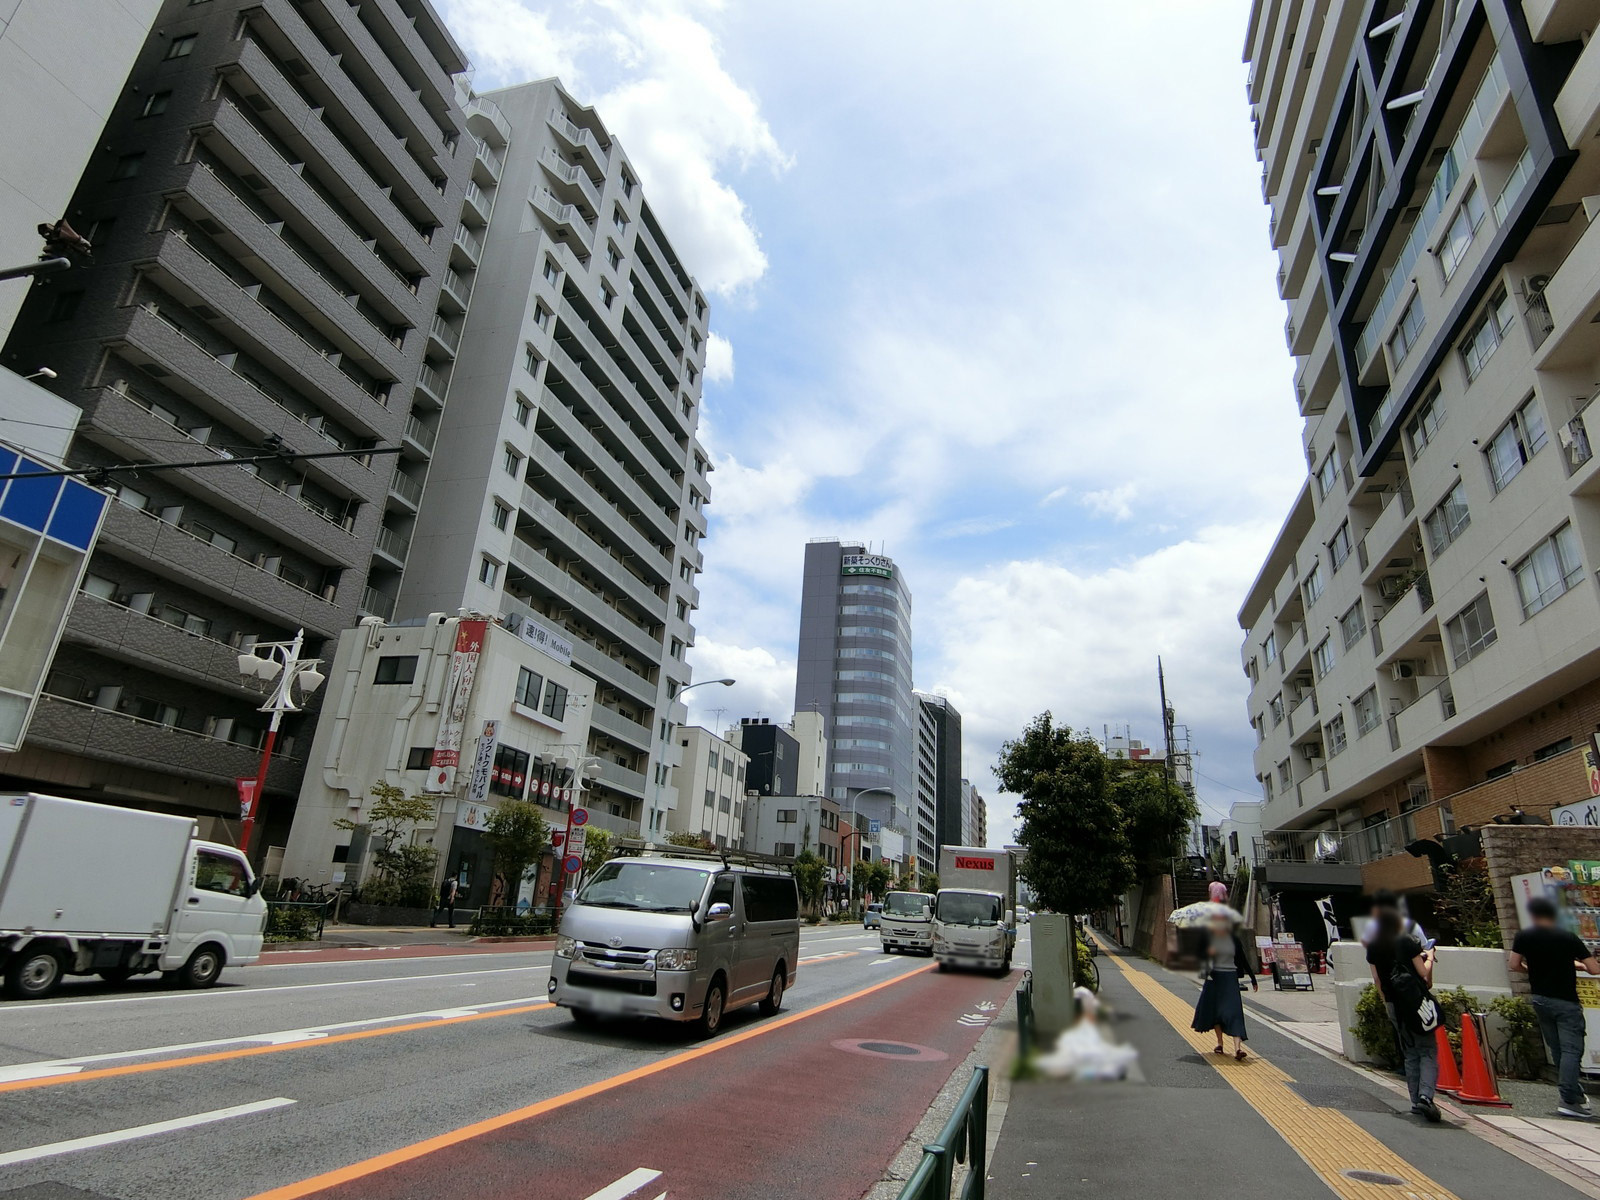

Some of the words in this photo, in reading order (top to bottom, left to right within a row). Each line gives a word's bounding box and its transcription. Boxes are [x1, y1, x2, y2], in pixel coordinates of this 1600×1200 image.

[844, 556, 891, 569] 新築そっくりさん
[550, 639, 571, 658] Mobile
[475, 738, 494, 799] ソクトクモバイル
[955, 856, 995, 871] Nexus
